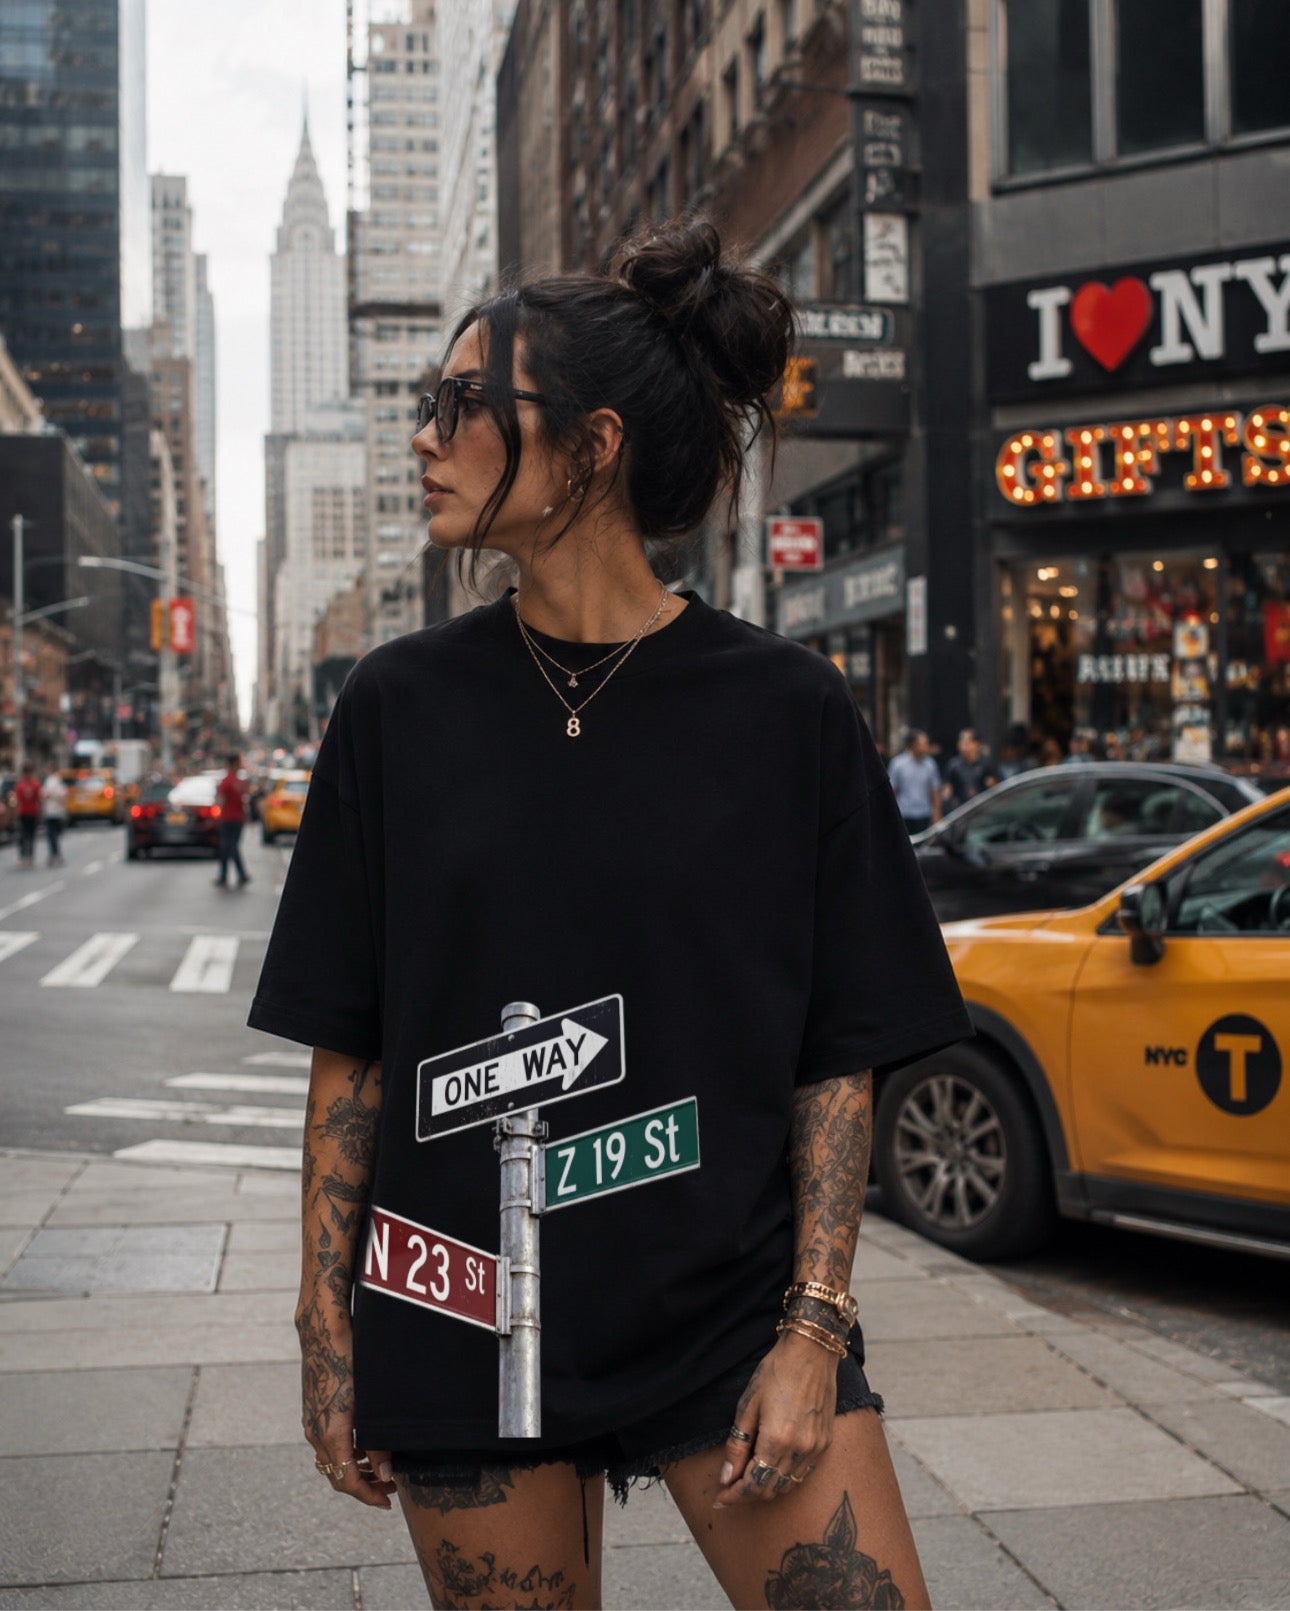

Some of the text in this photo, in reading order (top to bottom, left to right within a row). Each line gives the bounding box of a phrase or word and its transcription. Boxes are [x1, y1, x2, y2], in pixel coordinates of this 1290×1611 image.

[1027, 254, 1290, 381] I NY
[996, 405, 1290, 506] GIFTS
[566, 717, 581, 738] 8
[444, 1033, 587, 1106] ONE WAY
[1144, 1033, 1262, 1102] NYC T
[557, 1114, 680, 1196] Z 19 St
[364, 1218, 486, 1302] N 23 St
